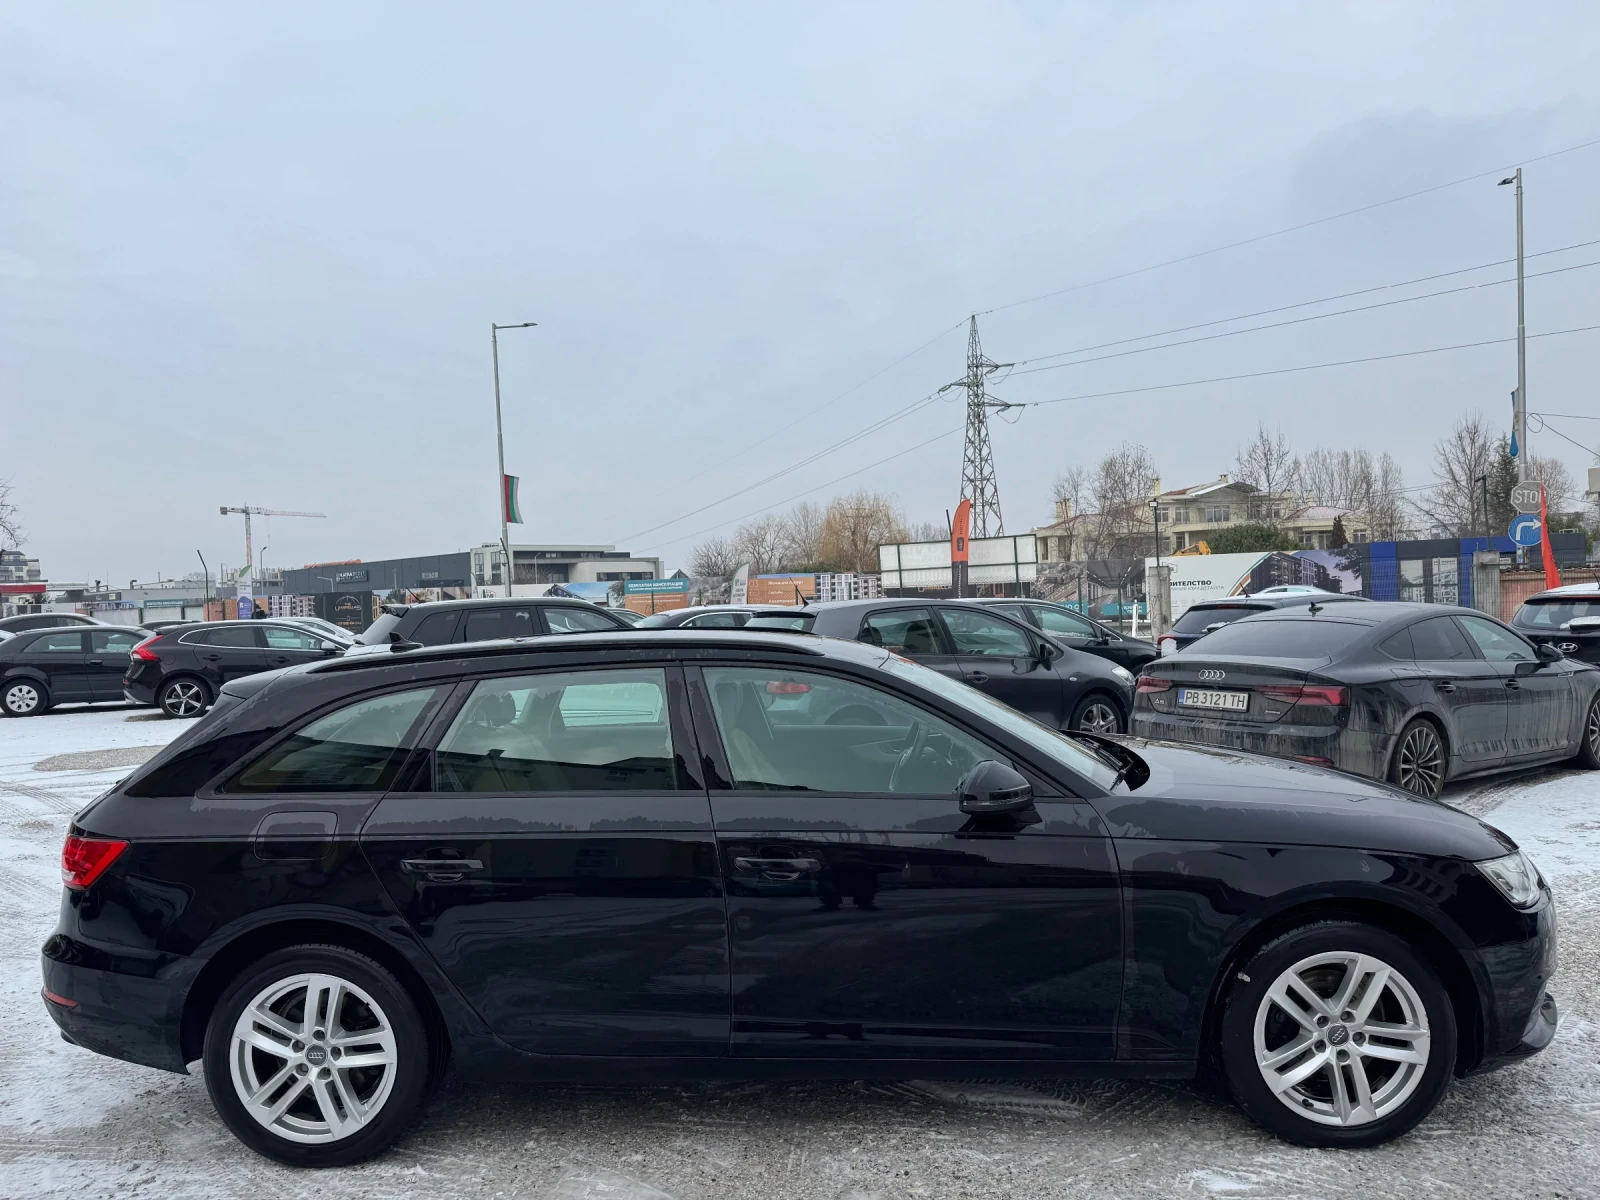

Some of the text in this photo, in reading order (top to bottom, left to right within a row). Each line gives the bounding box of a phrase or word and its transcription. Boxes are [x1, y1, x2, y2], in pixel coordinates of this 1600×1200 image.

[1184, 691, 1246, 708] PB 3121 TH
